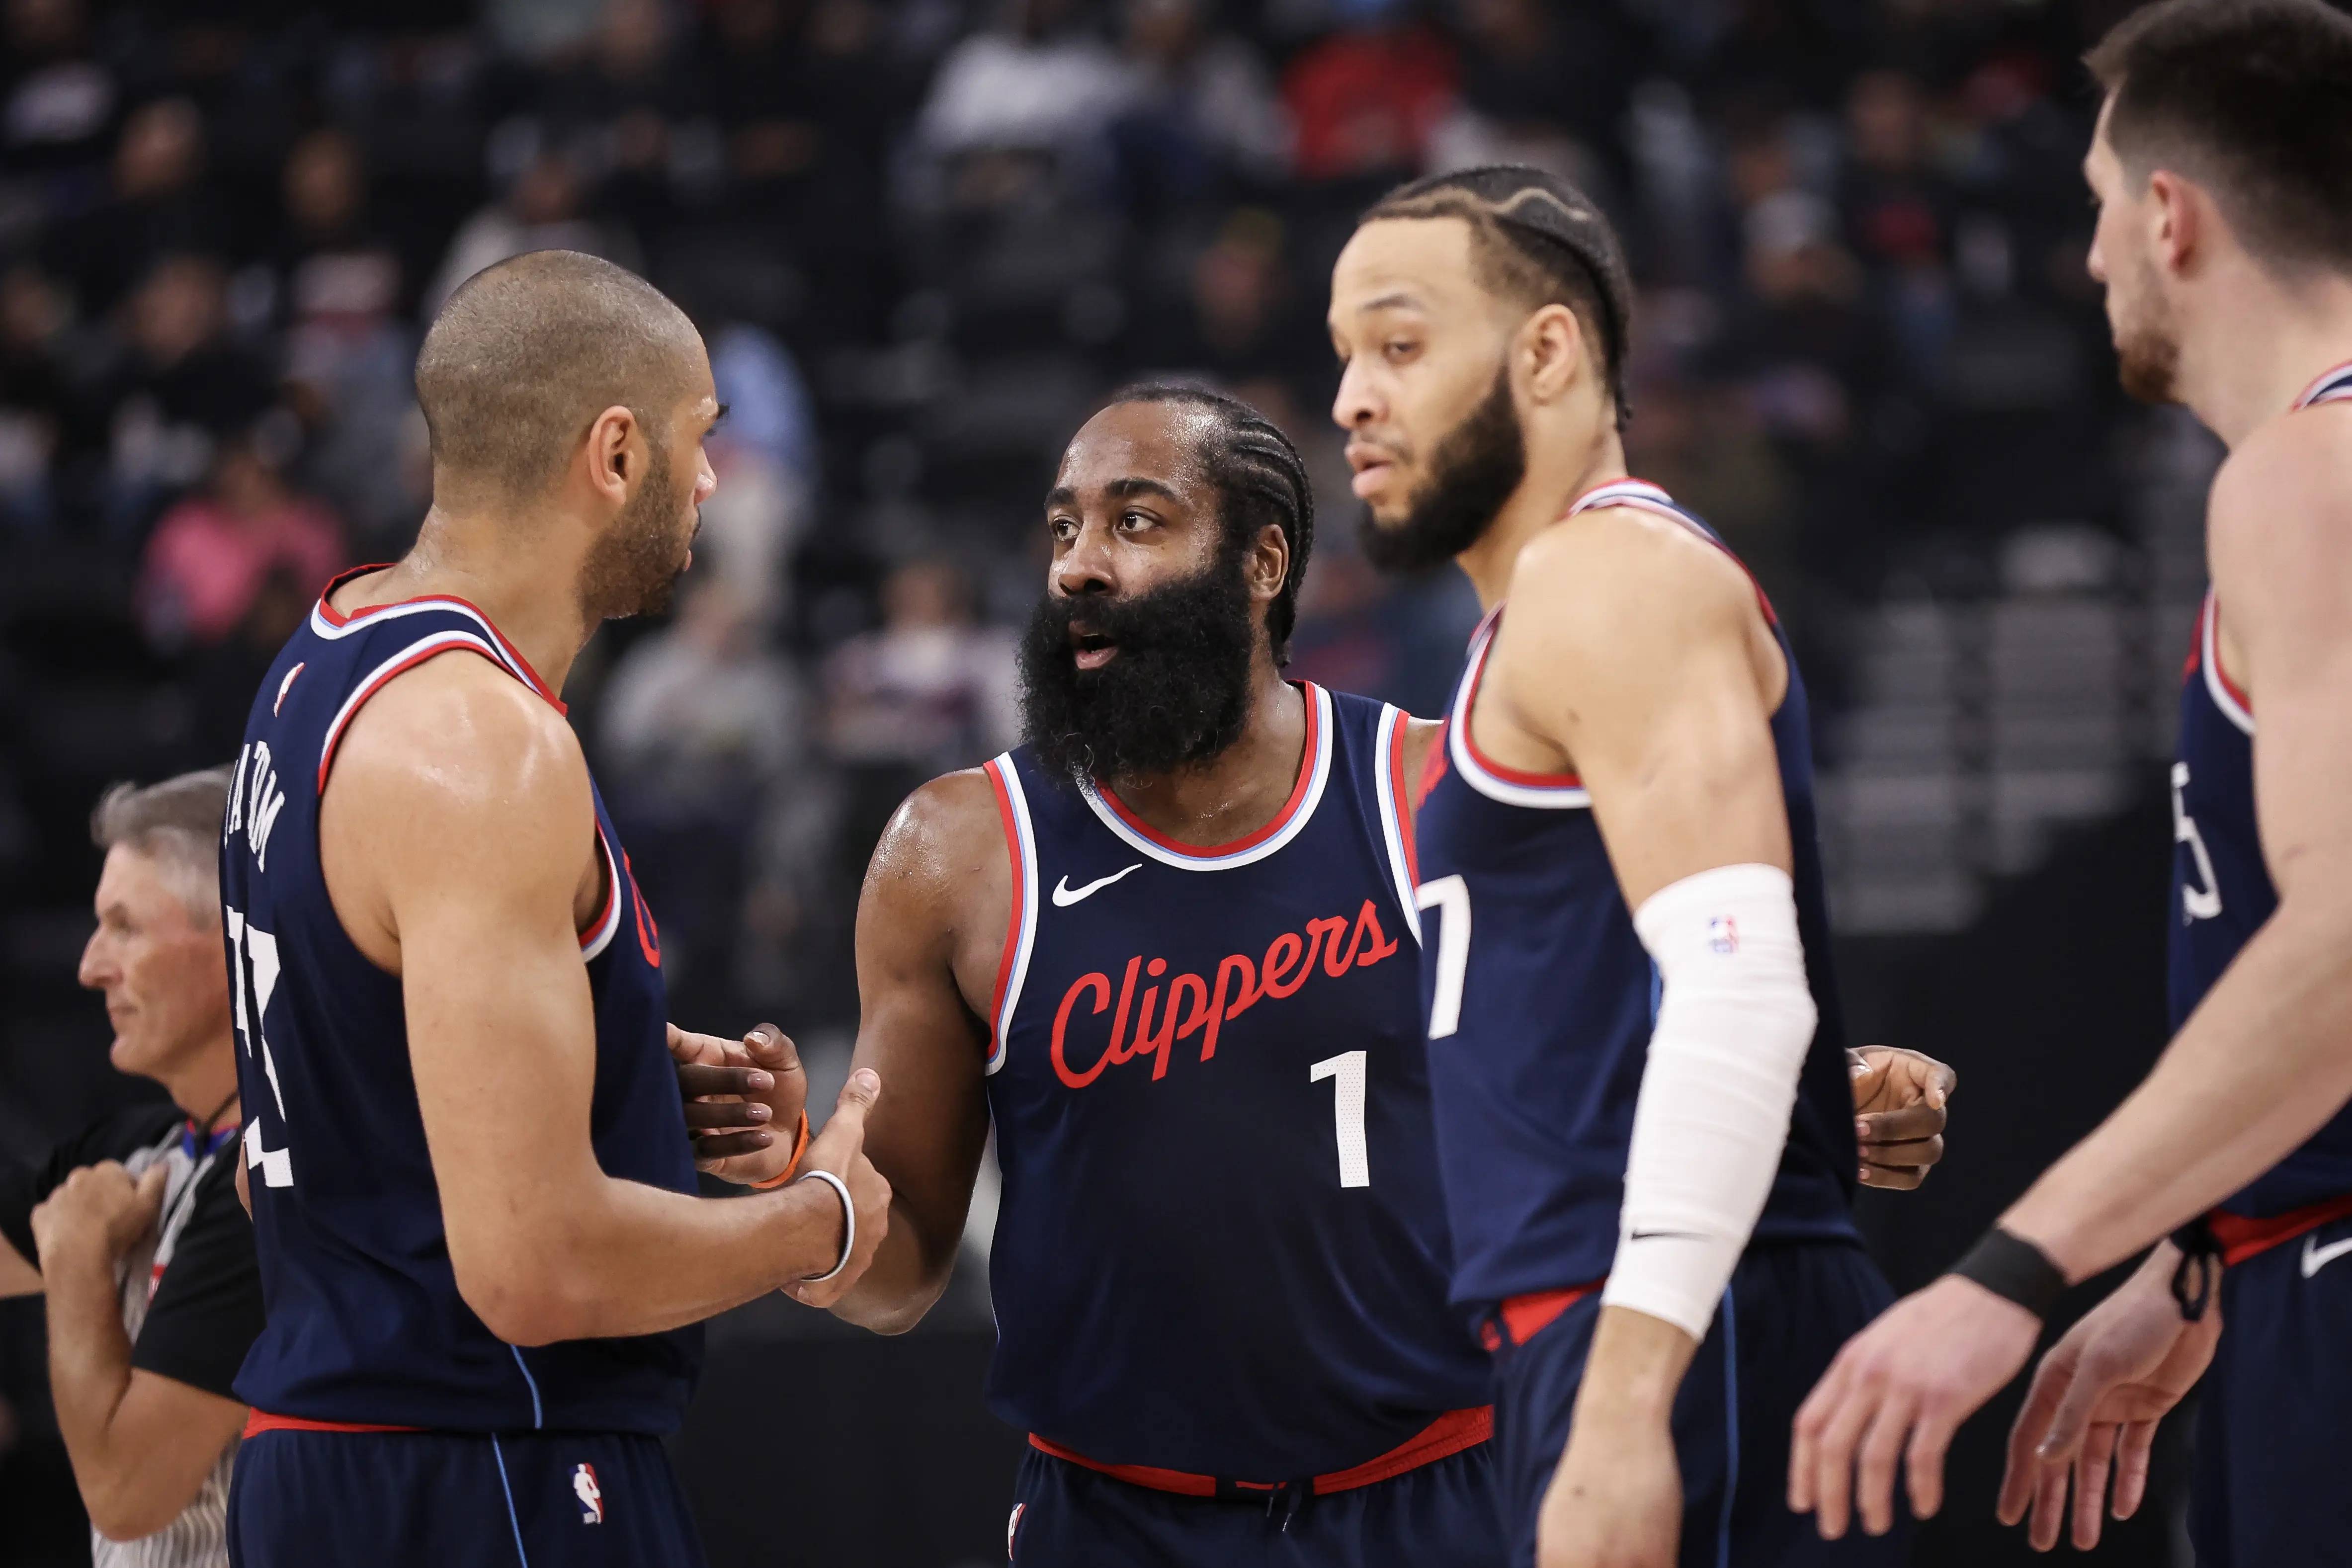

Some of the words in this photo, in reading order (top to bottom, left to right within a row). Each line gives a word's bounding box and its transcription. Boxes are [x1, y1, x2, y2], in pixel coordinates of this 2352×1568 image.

[1050, 899, 1398, 1089] Clippers
[1416, 873, 1472, 1040] 7
[1310, 1051, 1370, 1188] 1
